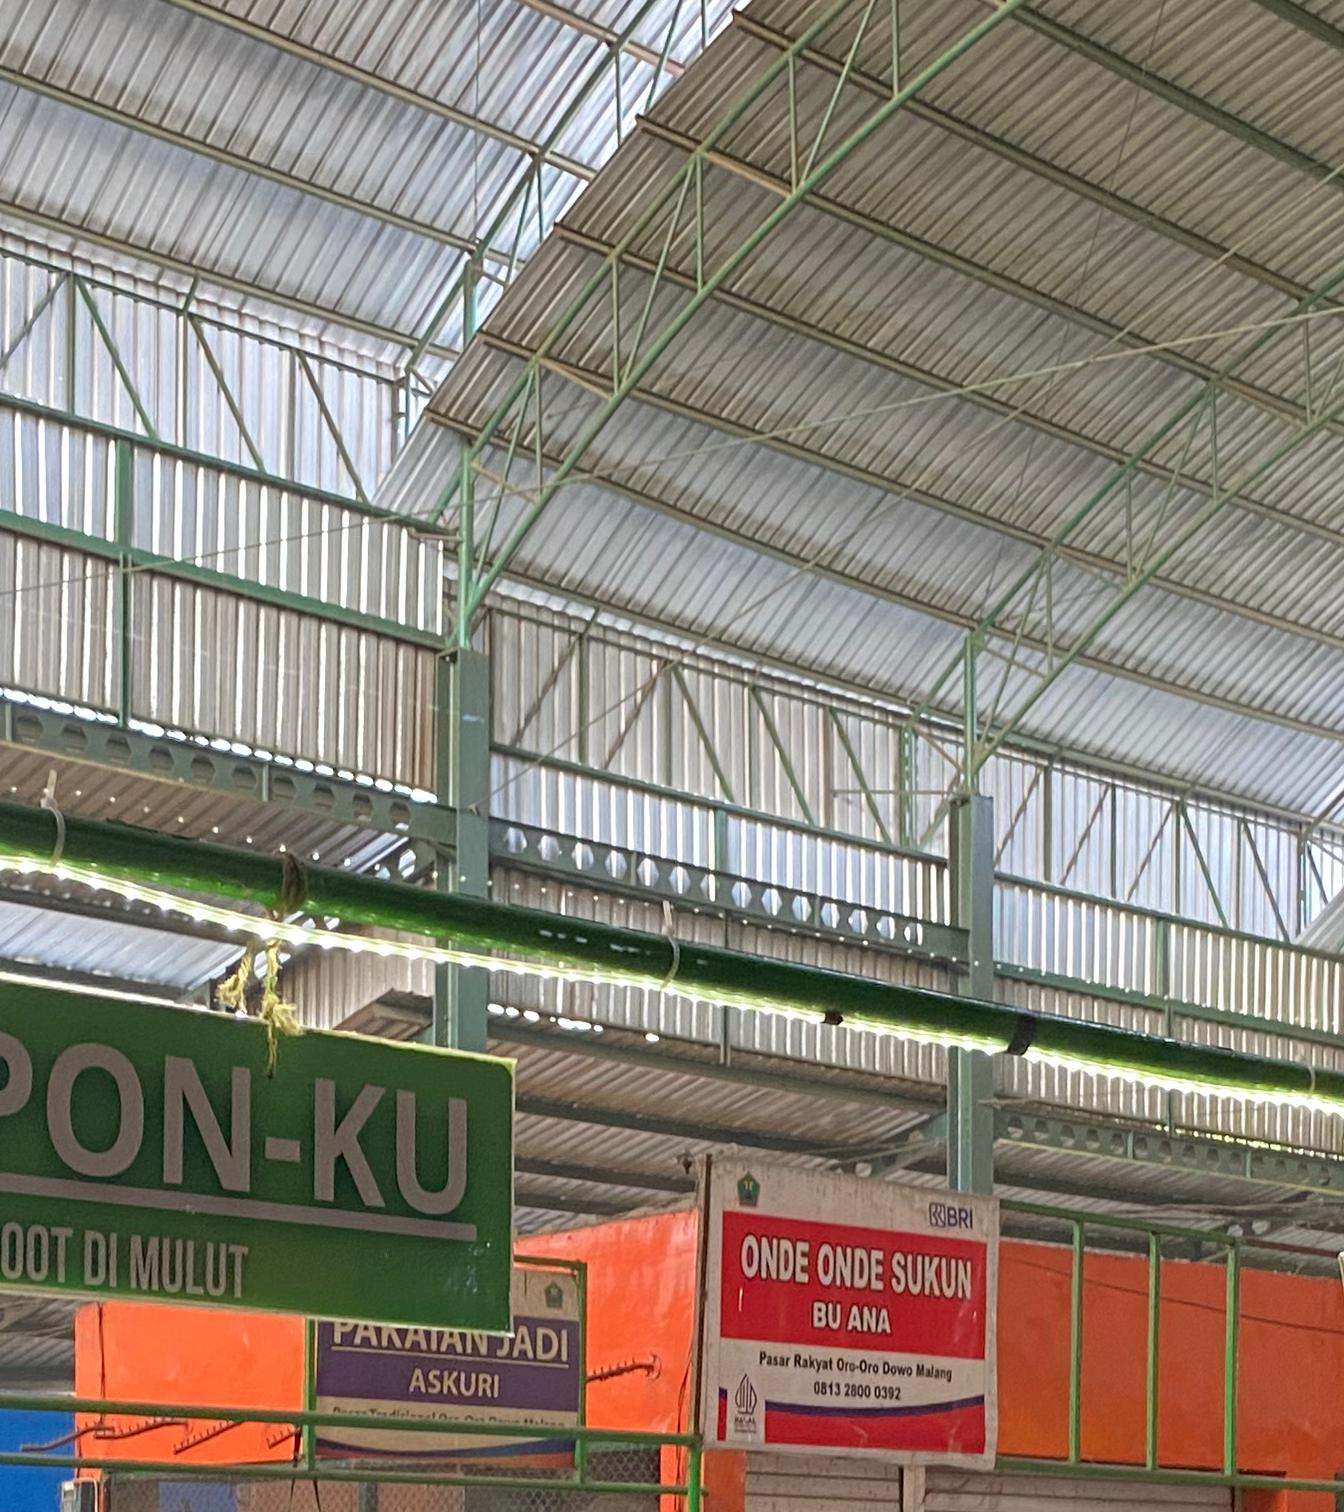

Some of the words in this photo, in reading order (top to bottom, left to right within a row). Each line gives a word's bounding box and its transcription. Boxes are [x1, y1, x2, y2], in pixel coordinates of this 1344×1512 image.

[947, 1206, 974, 1229] BRI
[83, 1229, 119, 1289] DI
[128, 1237, 251, 1299] MULUT
[740, 1233, 810, 1284] ONDE
[817, 1243, 885, 1291] ONDE
[890, 1251, 972, 1300] SUKUN
[812, 1301, 842, 1330] BU
[847, 1305, 892, 1334] ANA
[332, 1320, 489, 1356] PAKAIAN
[495, 1325, 569, 1363] JADI
[759, 1351, 790, 1367] Pasar
[793, 1354, 833, 1373] Rakyat
[836, 1358, 879, 1375] Oro-Oro
[882, 1361, 913, 1377] Dowo
[916, 1364, 953, 1383] Malang
[408, 1368, 500, 1399] ASKURI
[813, 1381, 841, 1397] 0813
[844, 1382, 871, 1398] 2800
[874, 1385, 902, 1401] 0392
